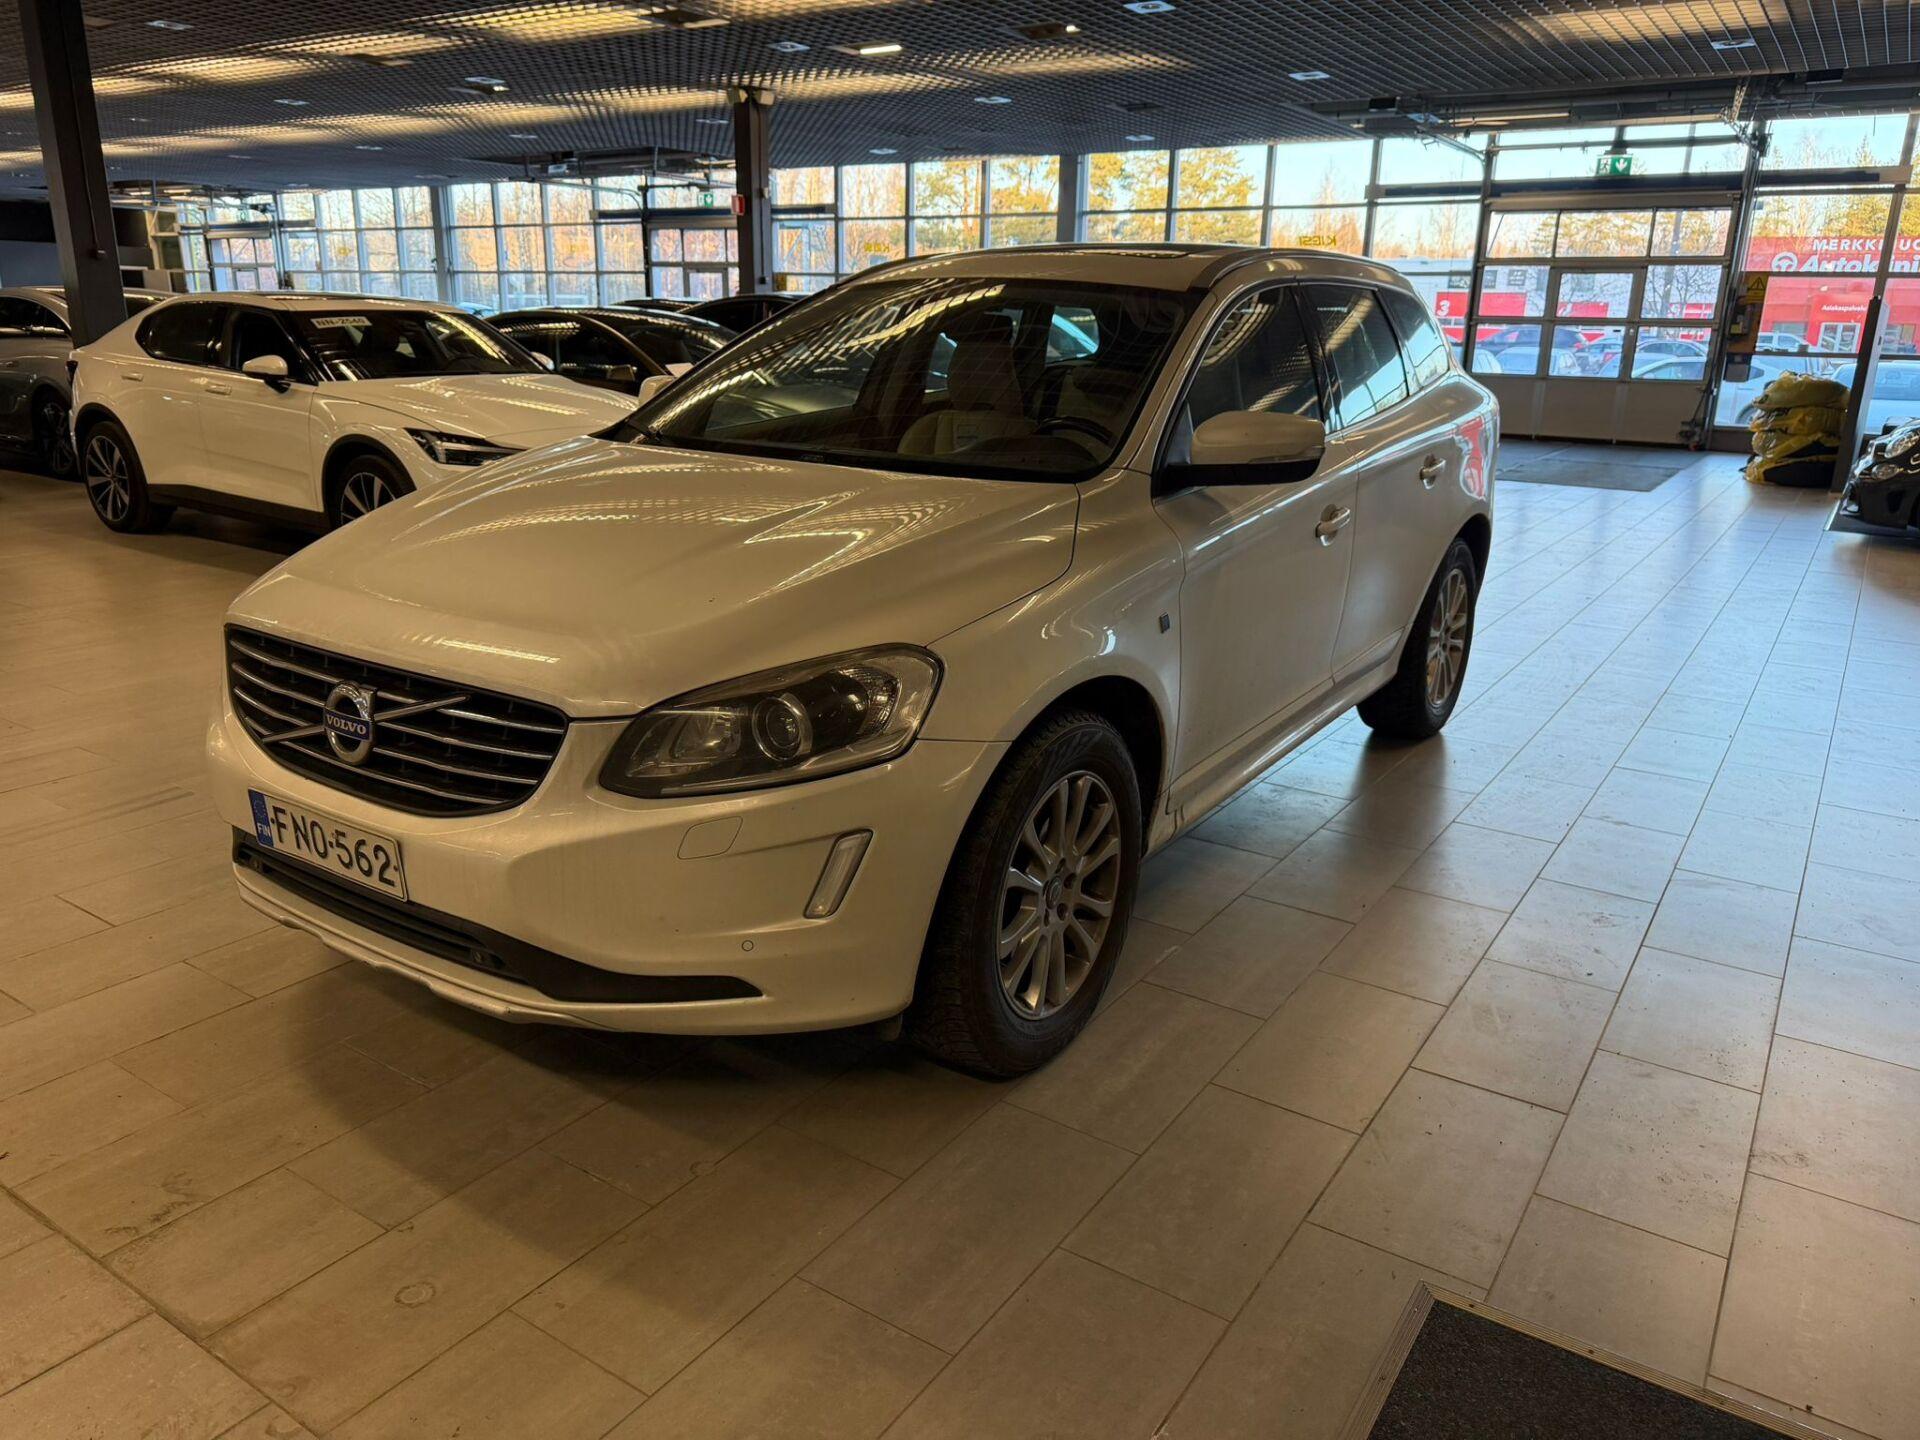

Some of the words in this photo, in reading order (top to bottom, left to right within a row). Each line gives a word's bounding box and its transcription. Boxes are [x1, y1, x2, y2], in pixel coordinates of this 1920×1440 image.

[1436, 300, 1450, 316] 3
[326, 714, 367, 735] VOLVO
[256, 822, 271, 838] FIN
[272, 805, 395, 887] FNO-562
